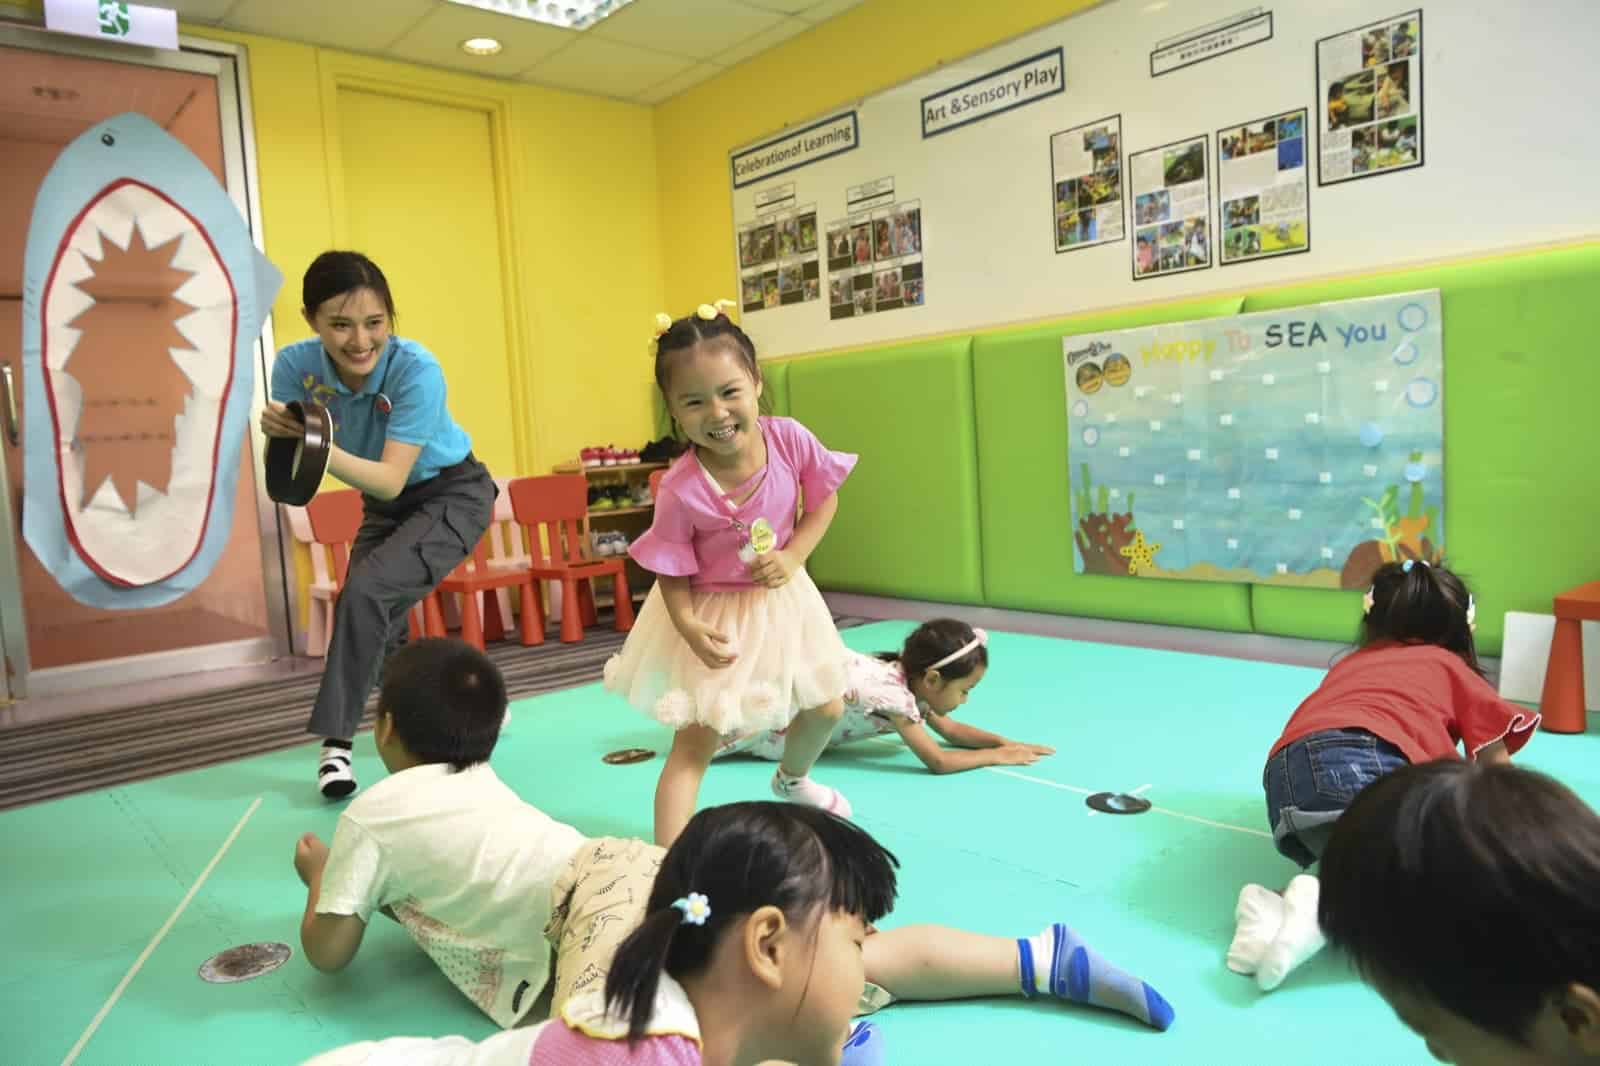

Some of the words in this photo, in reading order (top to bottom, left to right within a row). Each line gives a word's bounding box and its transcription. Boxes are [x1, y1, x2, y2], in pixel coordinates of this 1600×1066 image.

[926, 105, 946, 124] Art
[1024, 65, 1058, 90] Play
[804, 126, 851, 152] Learning
[1265, 320, 1327, 348] SEA
